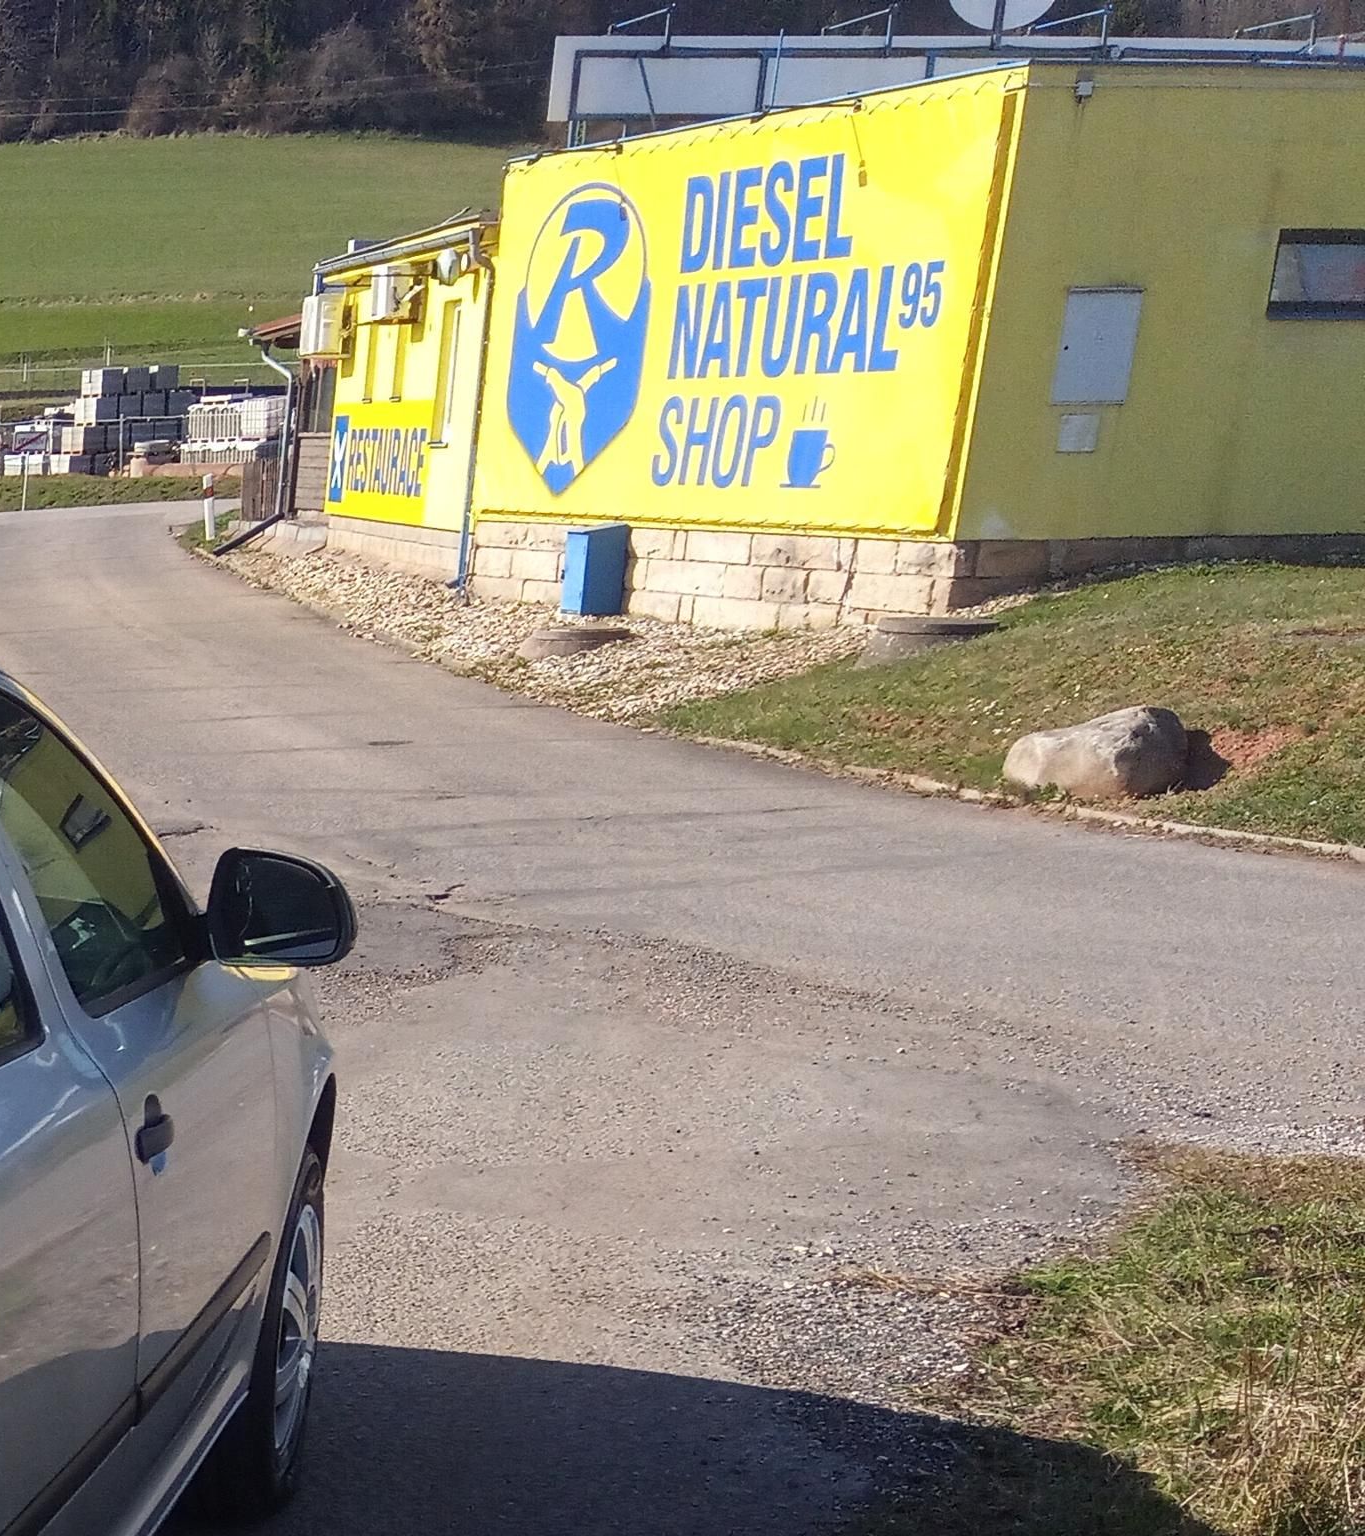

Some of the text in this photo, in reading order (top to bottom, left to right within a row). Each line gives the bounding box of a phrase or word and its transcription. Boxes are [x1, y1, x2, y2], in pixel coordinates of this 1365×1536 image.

[680, 153, 853, 274] DIESEL
[667, 260, 945, 380] NATURAL 95
[346, 428, 427, 498] RESTAURACE
[651, 394, 781, 489] SHOP
